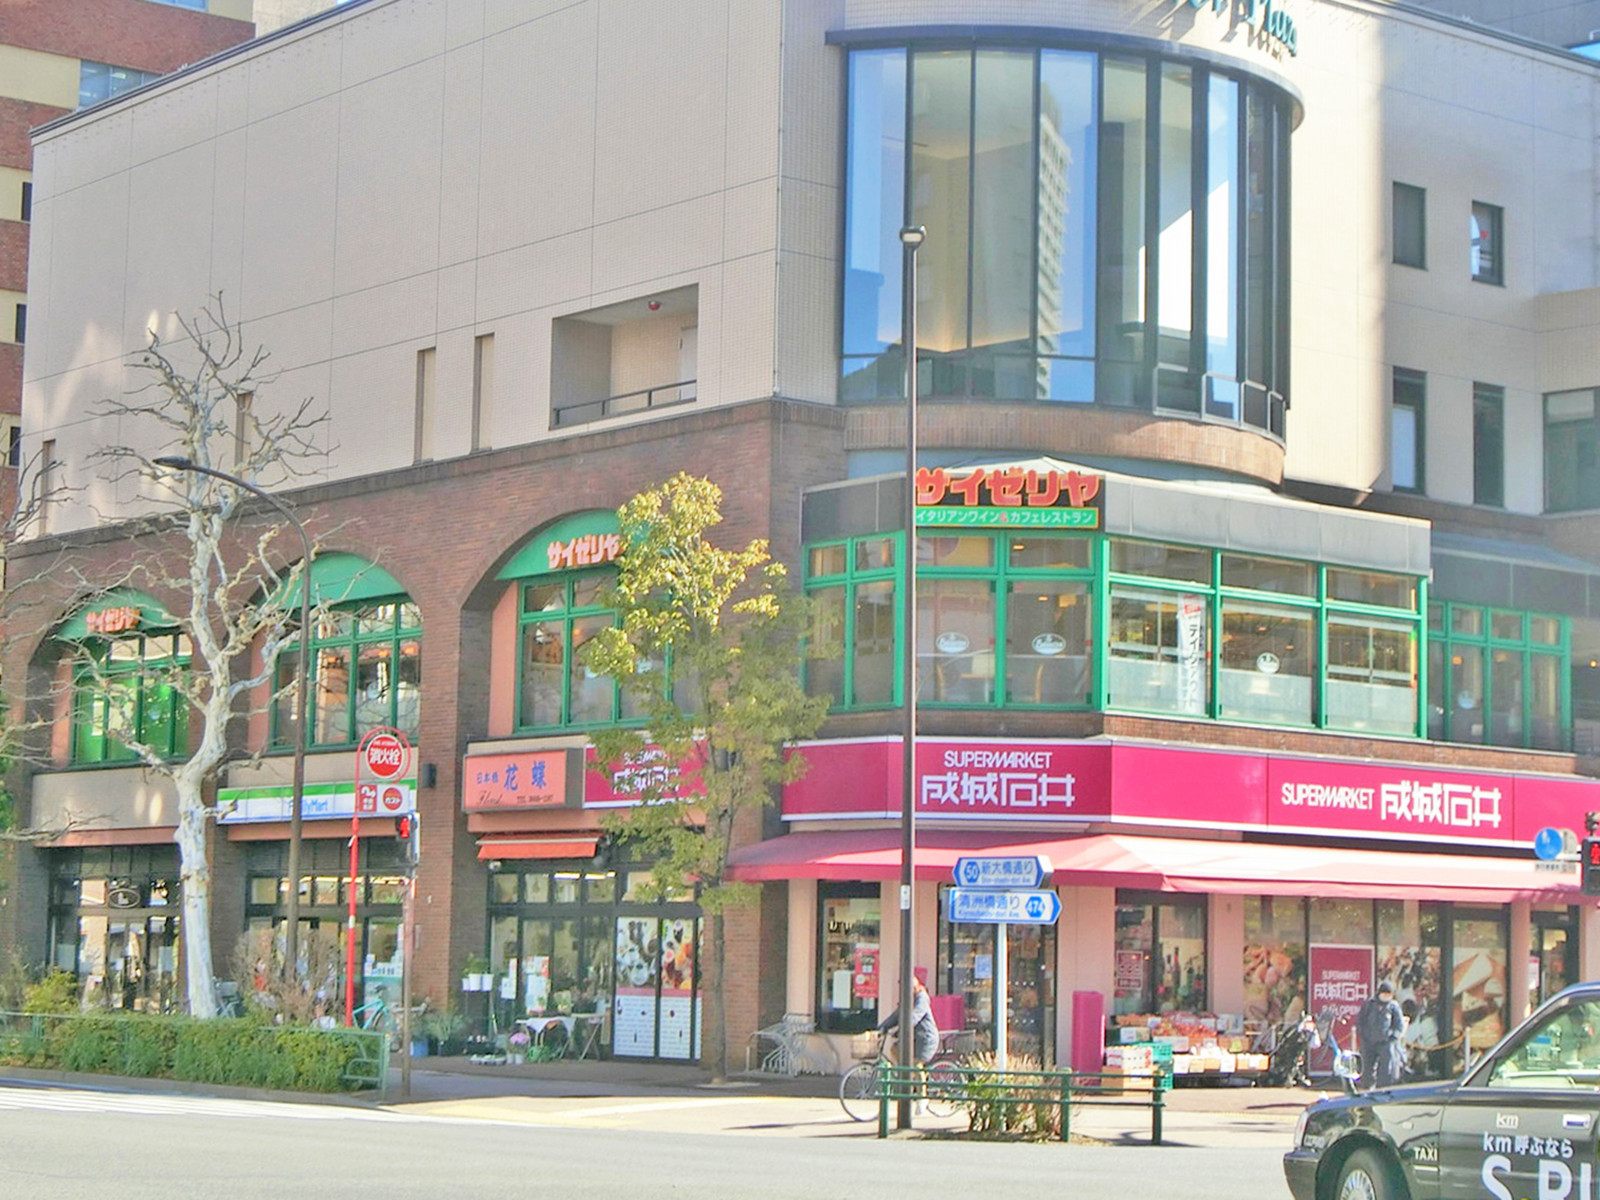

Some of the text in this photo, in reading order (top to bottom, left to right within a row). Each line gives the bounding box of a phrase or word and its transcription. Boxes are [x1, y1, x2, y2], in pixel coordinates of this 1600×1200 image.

[916, 467, 1100, 507] サイゼリヤ
[547, 533, 621, 569] サイゼリヤ
[370, 747, 400, 765] 消火栓
[944, 750, 1052, 768] SUPERMARKET
[922, 771, 1075, 807] 成城石井
[1281, 782, 1374, 810] SUPERMARKET
[1380, 780, 1502, 828] 成城石井
[966, 865, 978, 878] 50
[982, 861, 1032, 875] 新大橋通り
[1026, 899, 1045, 914] 474
[1314, 982, 1368, 1001] 成城石井
[1496, 1112, 1519, 1130] km
[1414, 1146, 1438, 1161] TAXI
